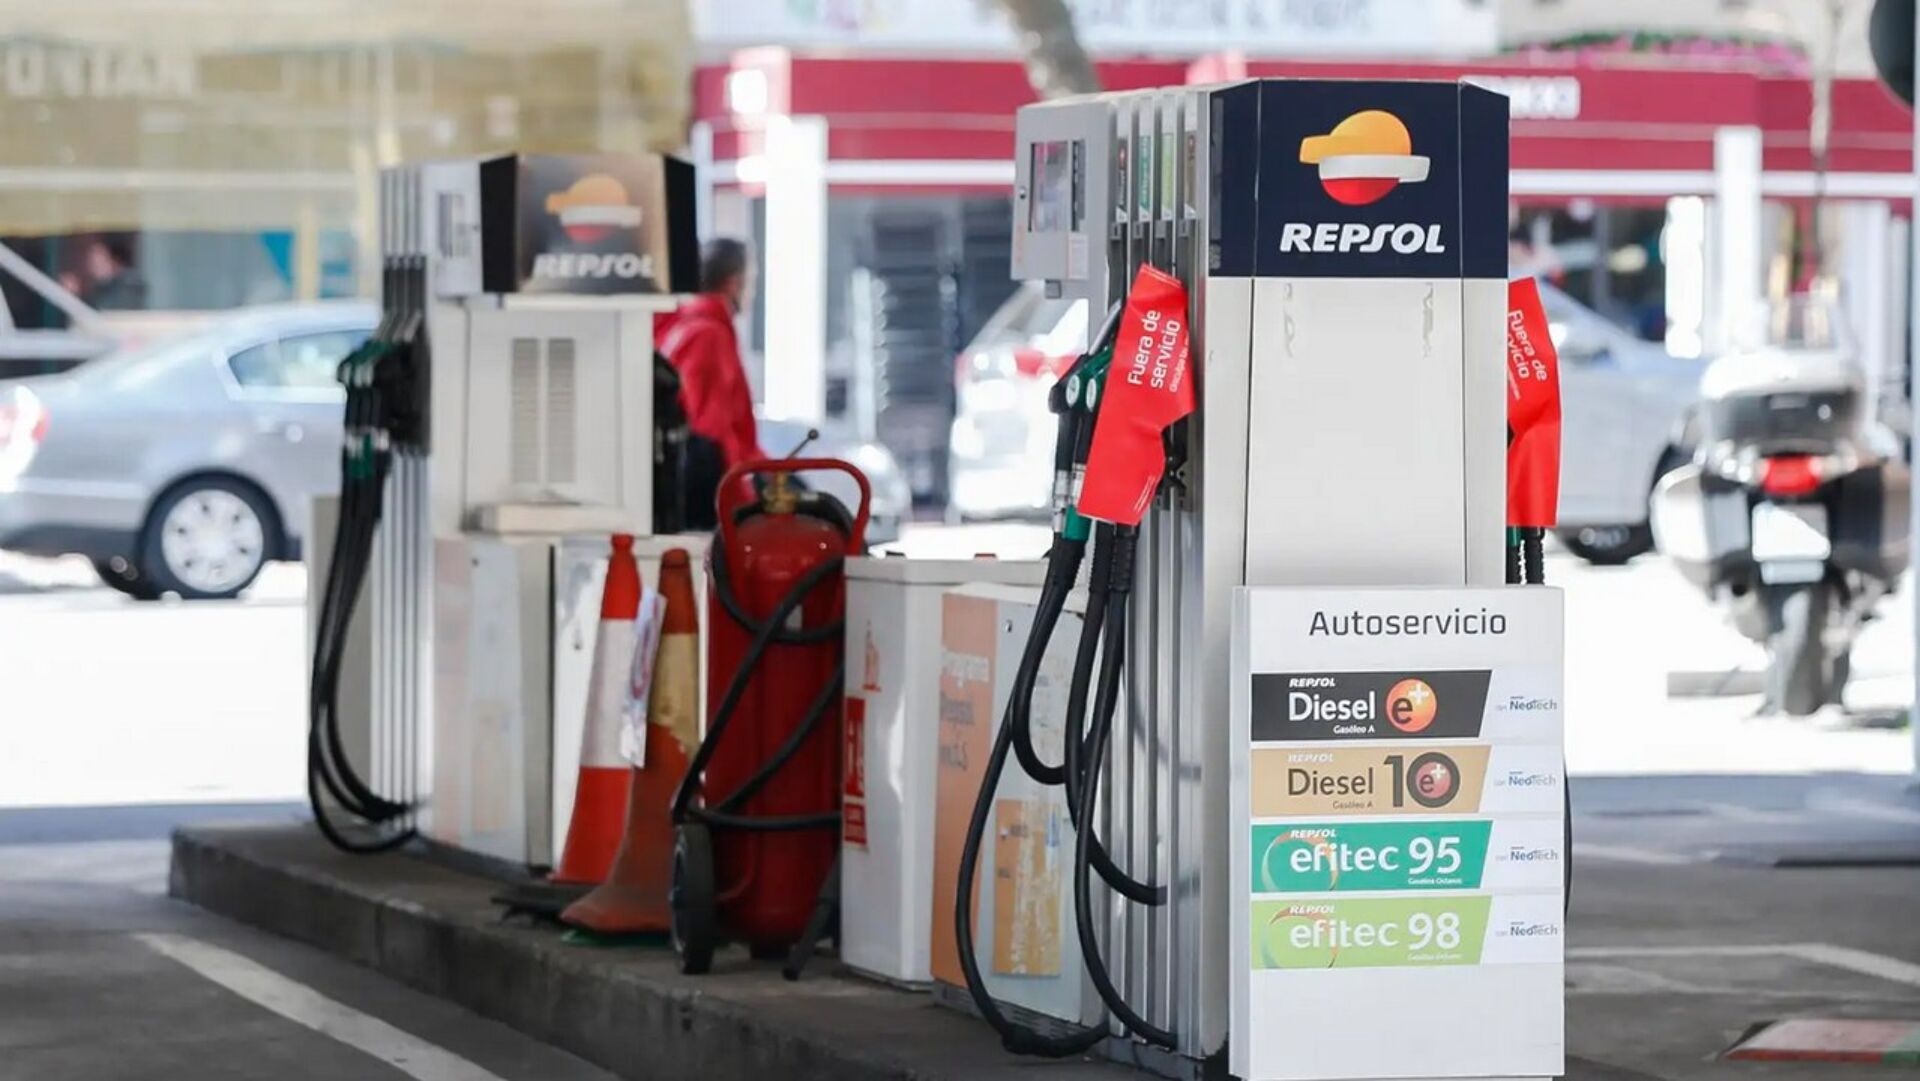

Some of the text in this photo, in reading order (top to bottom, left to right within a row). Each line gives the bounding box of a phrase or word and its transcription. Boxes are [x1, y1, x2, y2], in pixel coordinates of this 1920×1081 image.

[1279, 222, 1446, 254] REPSOL
[532, 253, 656, 280] REPSOL
[1127, 309, 1161, 385] Fuera de
[1150, 320, 1181, 389] servicio
[1508, 309, 1534, 357] Fuera
[1532, 357, 1548, 382] de
[1309, 607, 1507, 636] Autoservicio
[1289, 678, 1336, 688] REPSOL
[1289, 690, 1376, 722] Diesel
[1509, 697, 1558, 711] NeoTech
[1367, 725, 1376, 734] A
[1287, 753, 1334, 763] REPSOL
[1288, 767, 1374, 796] Diesel
[1508, 773, 1557, 787] NeoTech
[1366, 801, 1373, 809] A
[1290, 829, 1337, 839] REPSOL
[1290, 836, 1461, 875] efitec 95
[1510, 849, 1558, 862] NeoTech
[1289, 904, 1335, 915] REPSOL
[1290, 911, 1461, 951] efitec 98
[1510, 924, 1558, 937] NeoTech
